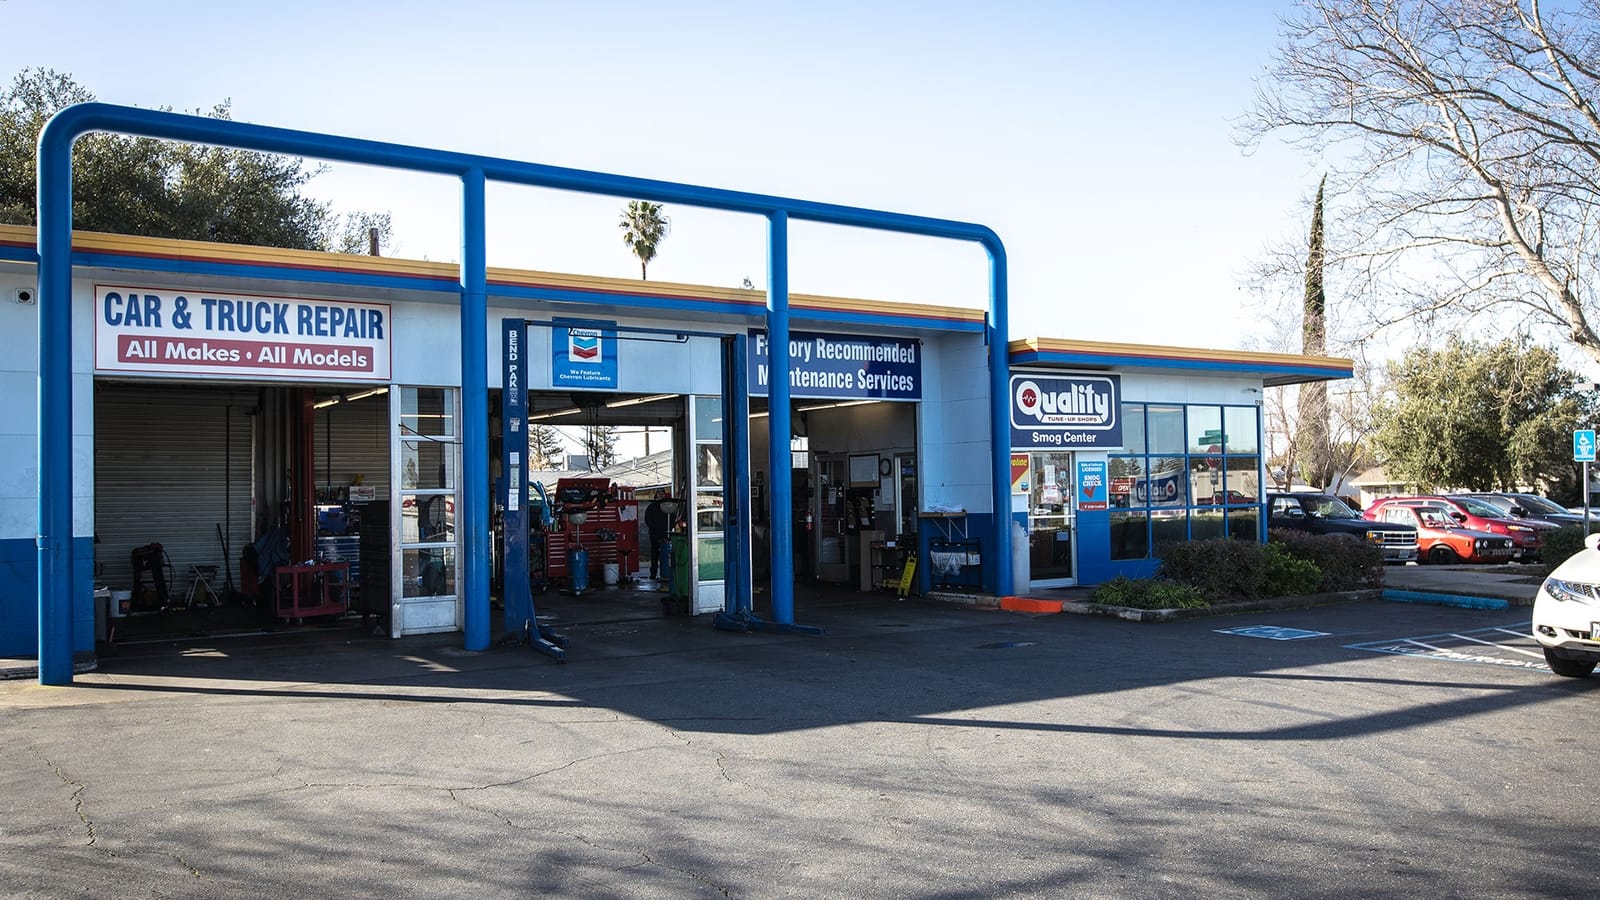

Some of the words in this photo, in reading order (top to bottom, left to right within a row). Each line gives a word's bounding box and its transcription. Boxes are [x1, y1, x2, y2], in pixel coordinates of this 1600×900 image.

[104, 291, 162, 329] CAR
[171, 296, 193, 329] &
[200, 298, 290, 335] TRUCK
[297, 304, 385, 340] REPAIR
[509, 330, 518, 360] BEND
[573, 329, 598, 337] Chevron
[125, 340, 158, 360] All
[165, 342, 240, 363] Makes
[257, 345, 287, 365] All
[293, 348, 368, 368] Models
[756, 334, 811, 363] Fory
[816, 338, 915, 364] Recommended
[509, 366, 518, 388] PAK
[758, 363, 853, 390] Mntenance
[857, 368, 914, 392] Services
[1016, 380, 1109, 423] Quality
[1032, 432, 1062, 445] Smog
[1063, 432, 1097, 443] Center
